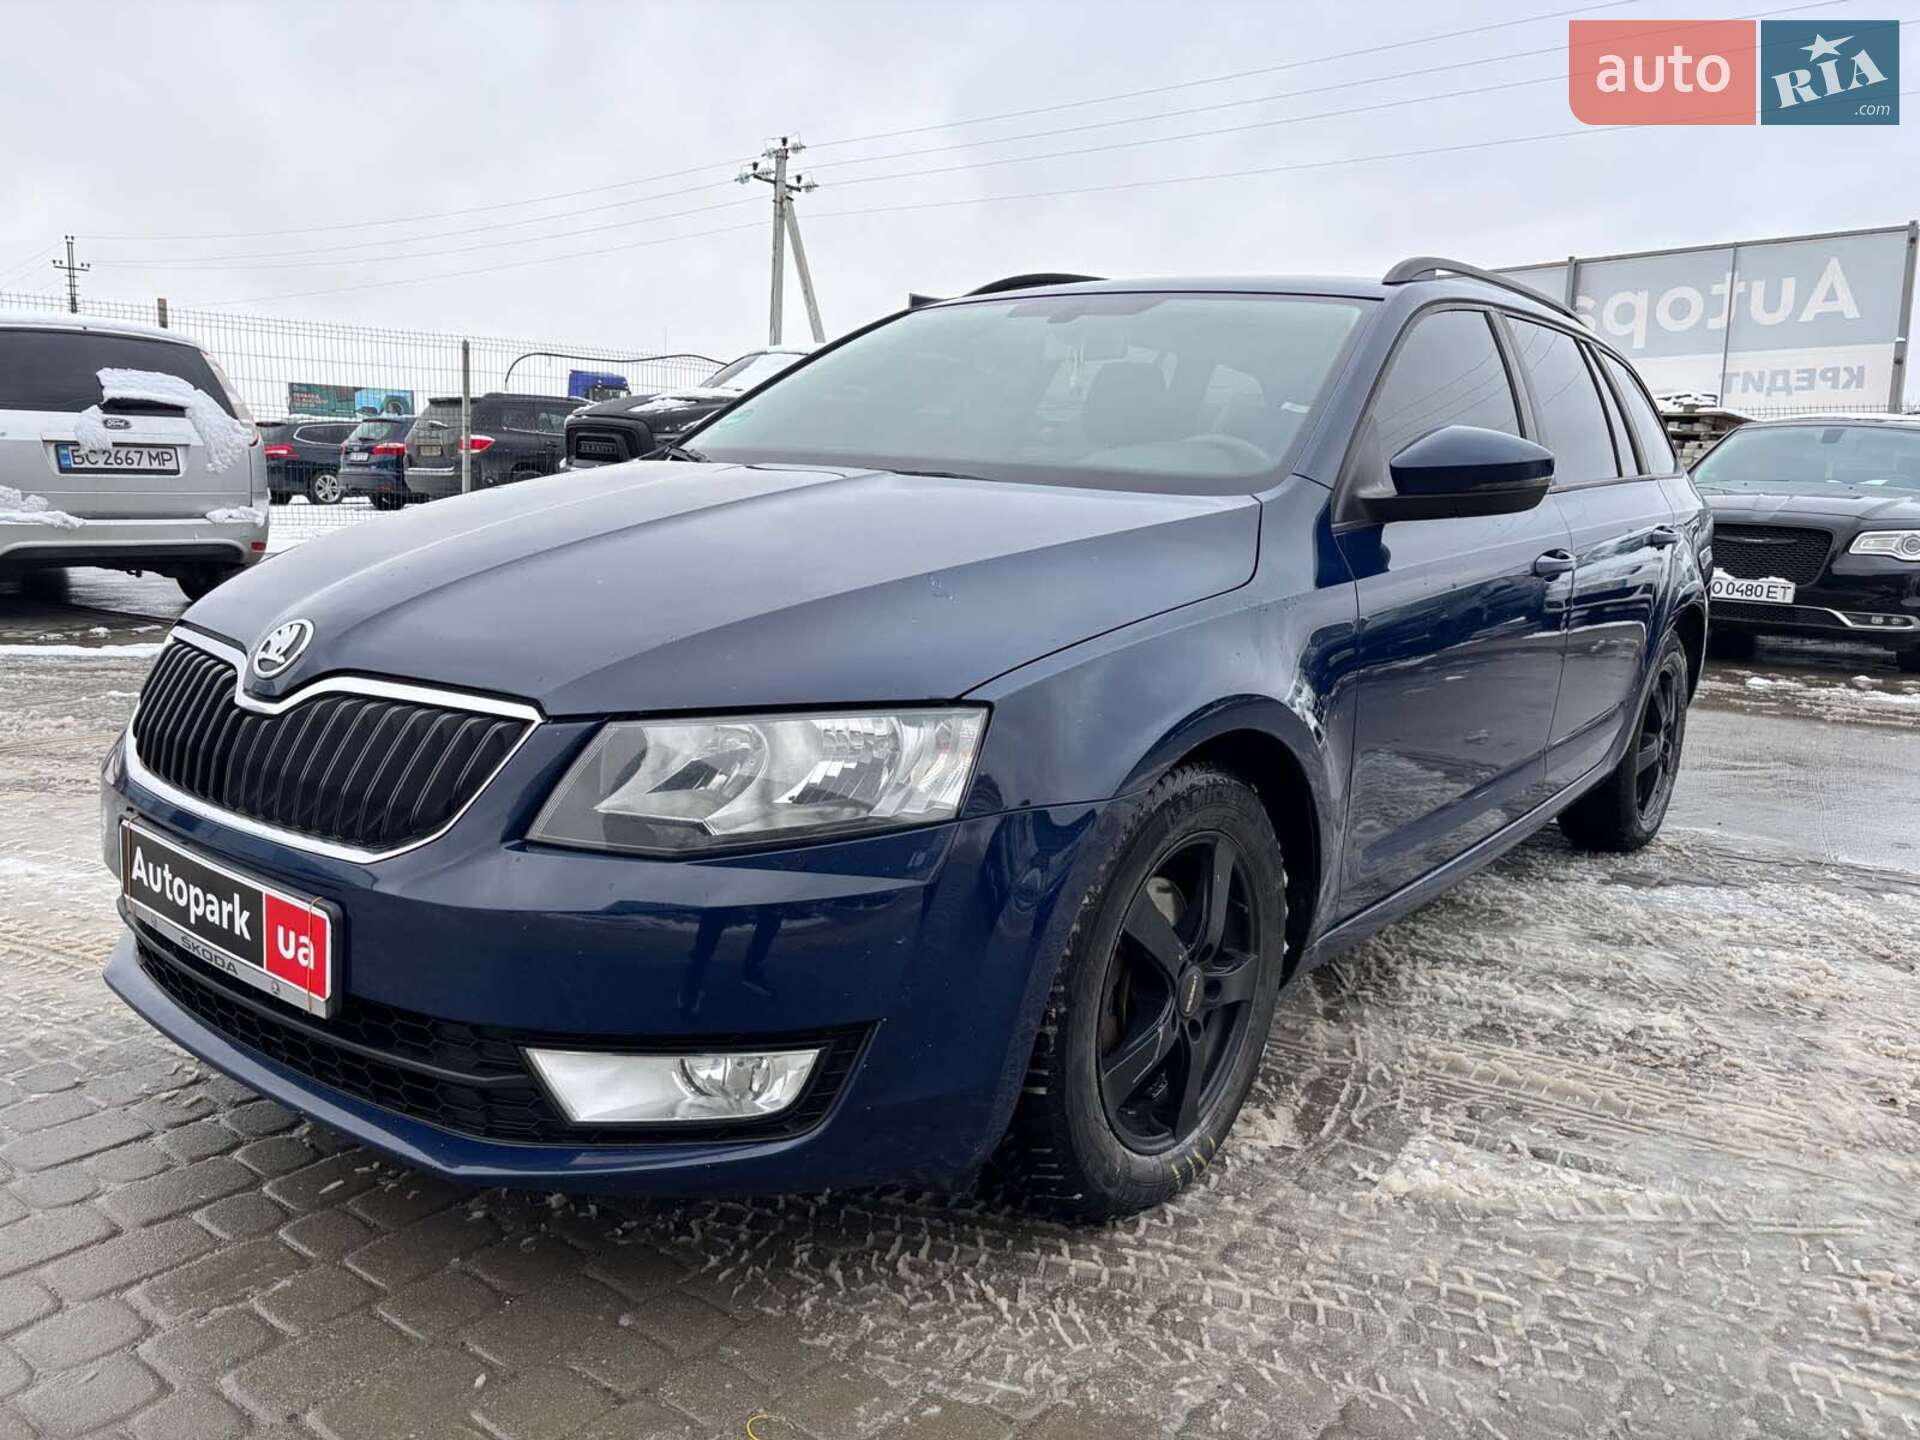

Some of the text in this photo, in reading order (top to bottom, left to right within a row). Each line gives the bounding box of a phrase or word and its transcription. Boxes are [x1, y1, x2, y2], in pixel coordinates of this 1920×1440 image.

[102, 450, 144, 467] 2667
[149, 450, 173, 467] MP
[1726, 582, 1764, 598] 0480
[1766, 585, 1792, 600] ET
[131, 845, 315, 970] Autopark ua
